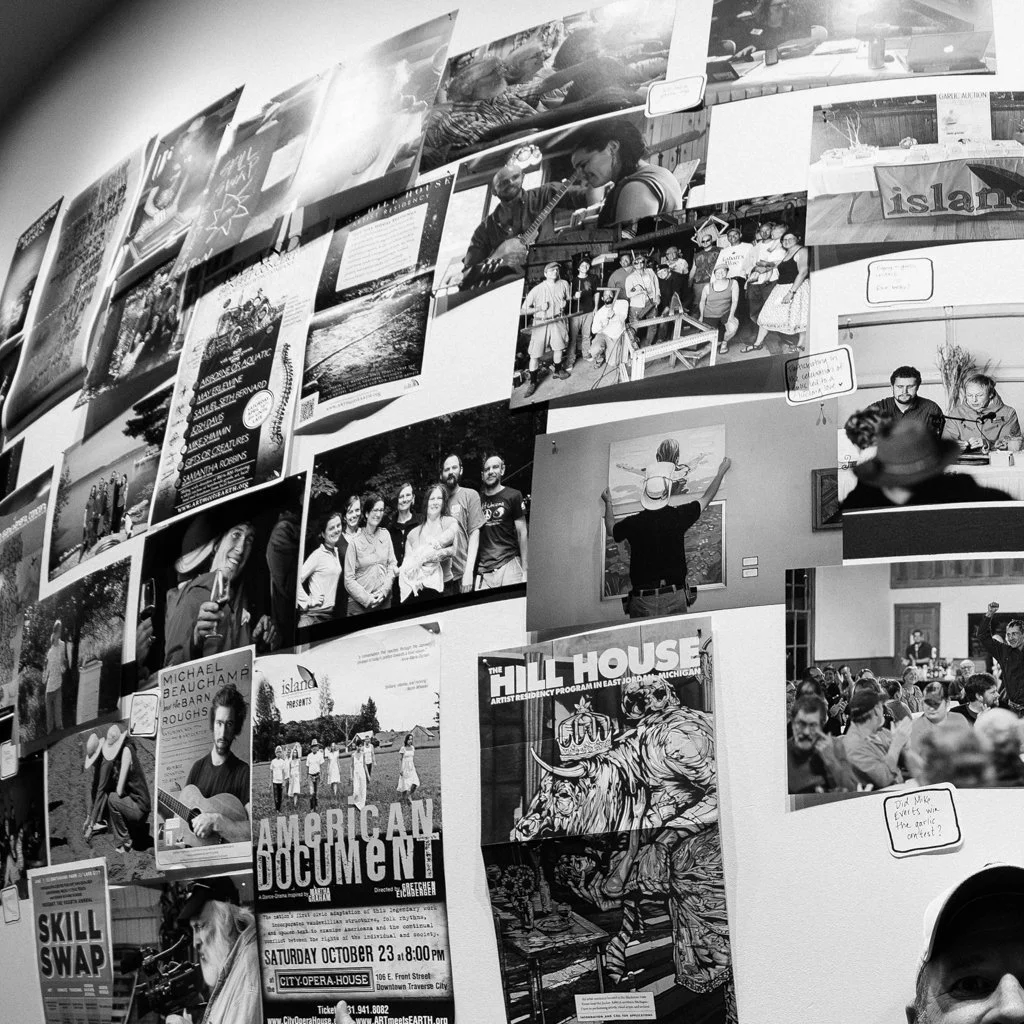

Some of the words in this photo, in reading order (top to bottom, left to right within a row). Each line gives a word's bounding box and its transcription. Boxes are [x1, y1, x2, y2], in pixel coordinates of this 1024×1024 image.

[197, 390, 211, 402] MAY
[211, 374, 244, 396] ERLEWINE
[194, 402, 218, 419] SAMUEL
[235, 380, 267, 398] BERNARD
[163, 662, 223, 686] MICHAEL
[488, 666, 502, 675] THE
[490, 658, 563, 698] HILL
[573, 636, 701, 684] HOUSE
[163, 668, 249, 698] BEAUCHAMP
[281, 672, 318, 695] island
[490, 695, 515, 705] ARTIST
[515, 689, 554, 701] RESIDENCY
[555, 683, 593, 695] PROGRAM
[593, 680, 602, 688] IN
[603, 678, 621, 687] EAST
[658, 667, 701, 680] MICHIGAN
[182, 692, 210, 708] BARN
[163, 707, 208, 724] ROUGHS
[894, 797, 910, 809] Did
[914, 795, 931, 805] Mike
[894, 807, 921, 821] Everts
[895, 820, 911, 830] the
[914, 816, 936, 829] garlic
[396, 888, 436, 898] EICHBERGER
[401, 881, 436, 891] GRETCHEN
[308, 893, 331, 902] GRAHAM
[330, 909, 360, 917] adaptation
[389, 906, 419, 915] legendary
[38, 909, 104, 945] SKILL
[40, 944, 107, 979] SWAP
[264, 948, 317, 965] SATURDAY
[378, 944, 394, 961] 23
[405, 945, 430, 961] 8:00
[432, 950, 445, 961] PM
[412, 972, 431, 980] Street
[376, 983, 406, 991] Downtown
[436, 982, 448, 991] City
